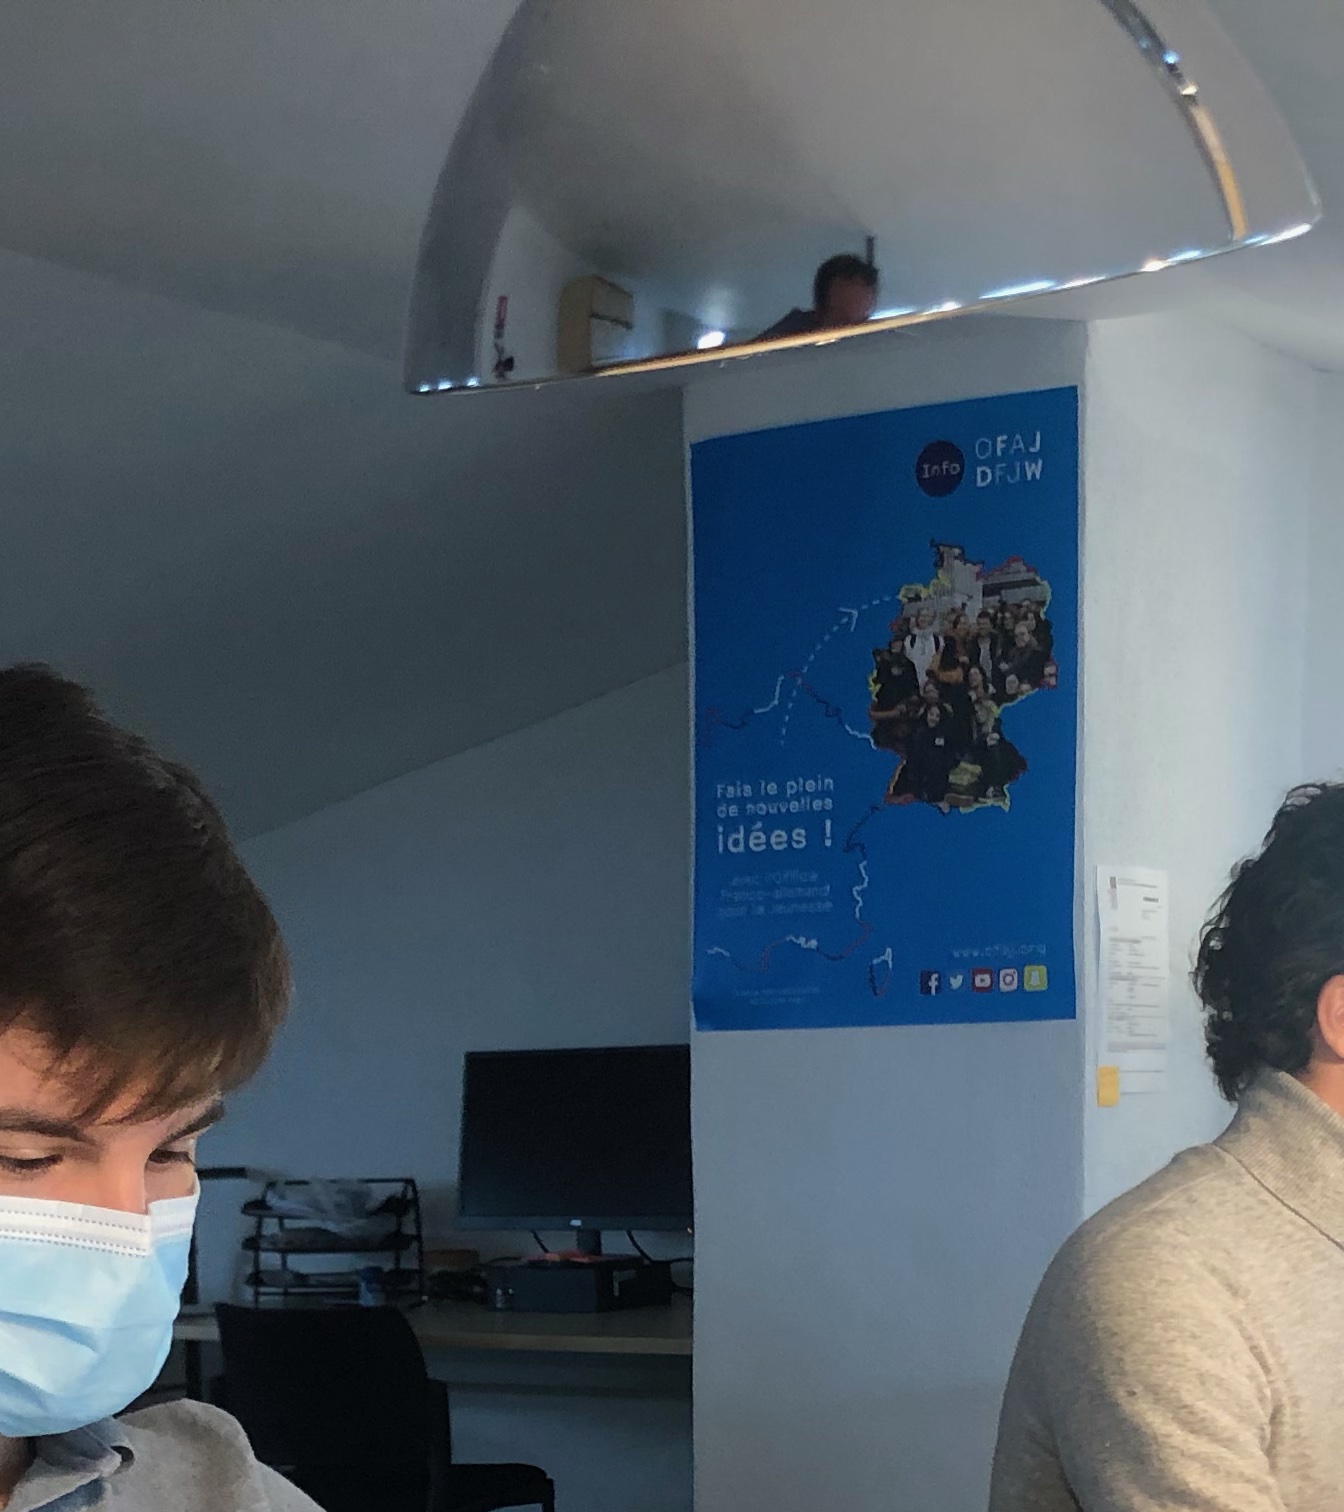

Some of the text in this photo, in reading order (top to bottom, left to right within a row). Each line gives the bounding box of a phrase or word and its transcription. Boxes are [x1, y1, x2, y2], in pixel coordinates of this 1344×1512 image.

[975, 431, 1041, 459] OFAJ
[922, 461, 960, 478] Info
[976, 458, 1043, 487] DFJW
[717, 774, 834, 798] Fais le plein
[717, 797, 833, 818] de nouvelles
[717, 819, 831, 854] idées !
